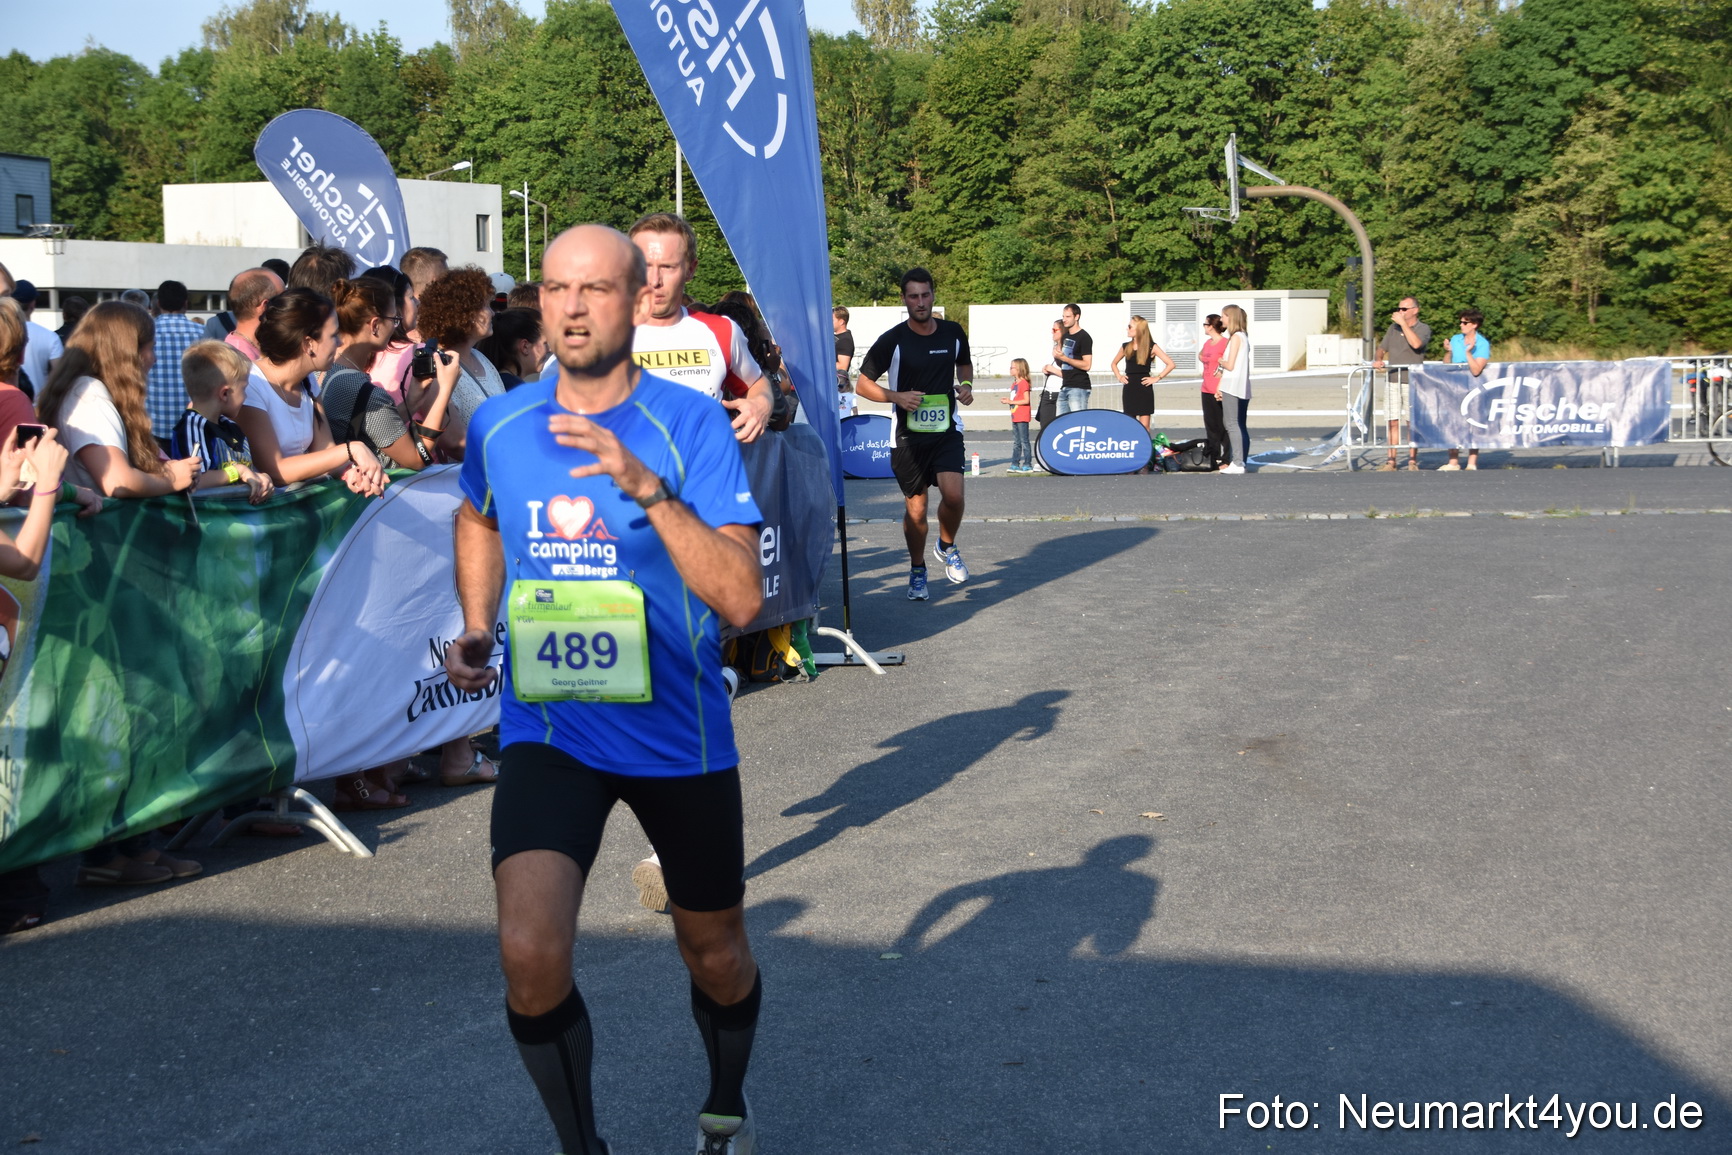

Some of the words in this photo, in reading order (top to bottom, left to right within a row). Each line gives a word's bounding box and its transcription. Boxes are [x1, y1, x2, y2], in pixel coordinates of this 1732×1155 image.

[639, 351, 703, 367] NLINE
[669, 367, 712, 377] Germany
[912, 409, 946, 422] 1093
[1487, 396, 1617, 422] Fischer
[1499, 423, 1605, 435] AUTOMOBILE
[416, 441, 431, 461] SONY
[849, 441, 865, 452] und
[866, 439, 880, 449] das
[1068, 436, 1139, 453] Fischer
[1076, 452, 1135, 460] AUTOMOBILE
[527, 500, 544, 538] I
[529, 538, 617, 565] camping
[584, 564, 618, 578] Berger
[537, 631, 619, 670] 489
[551, 678, 576, 688] Georg
[577, 678, 608, 686] Geitner
